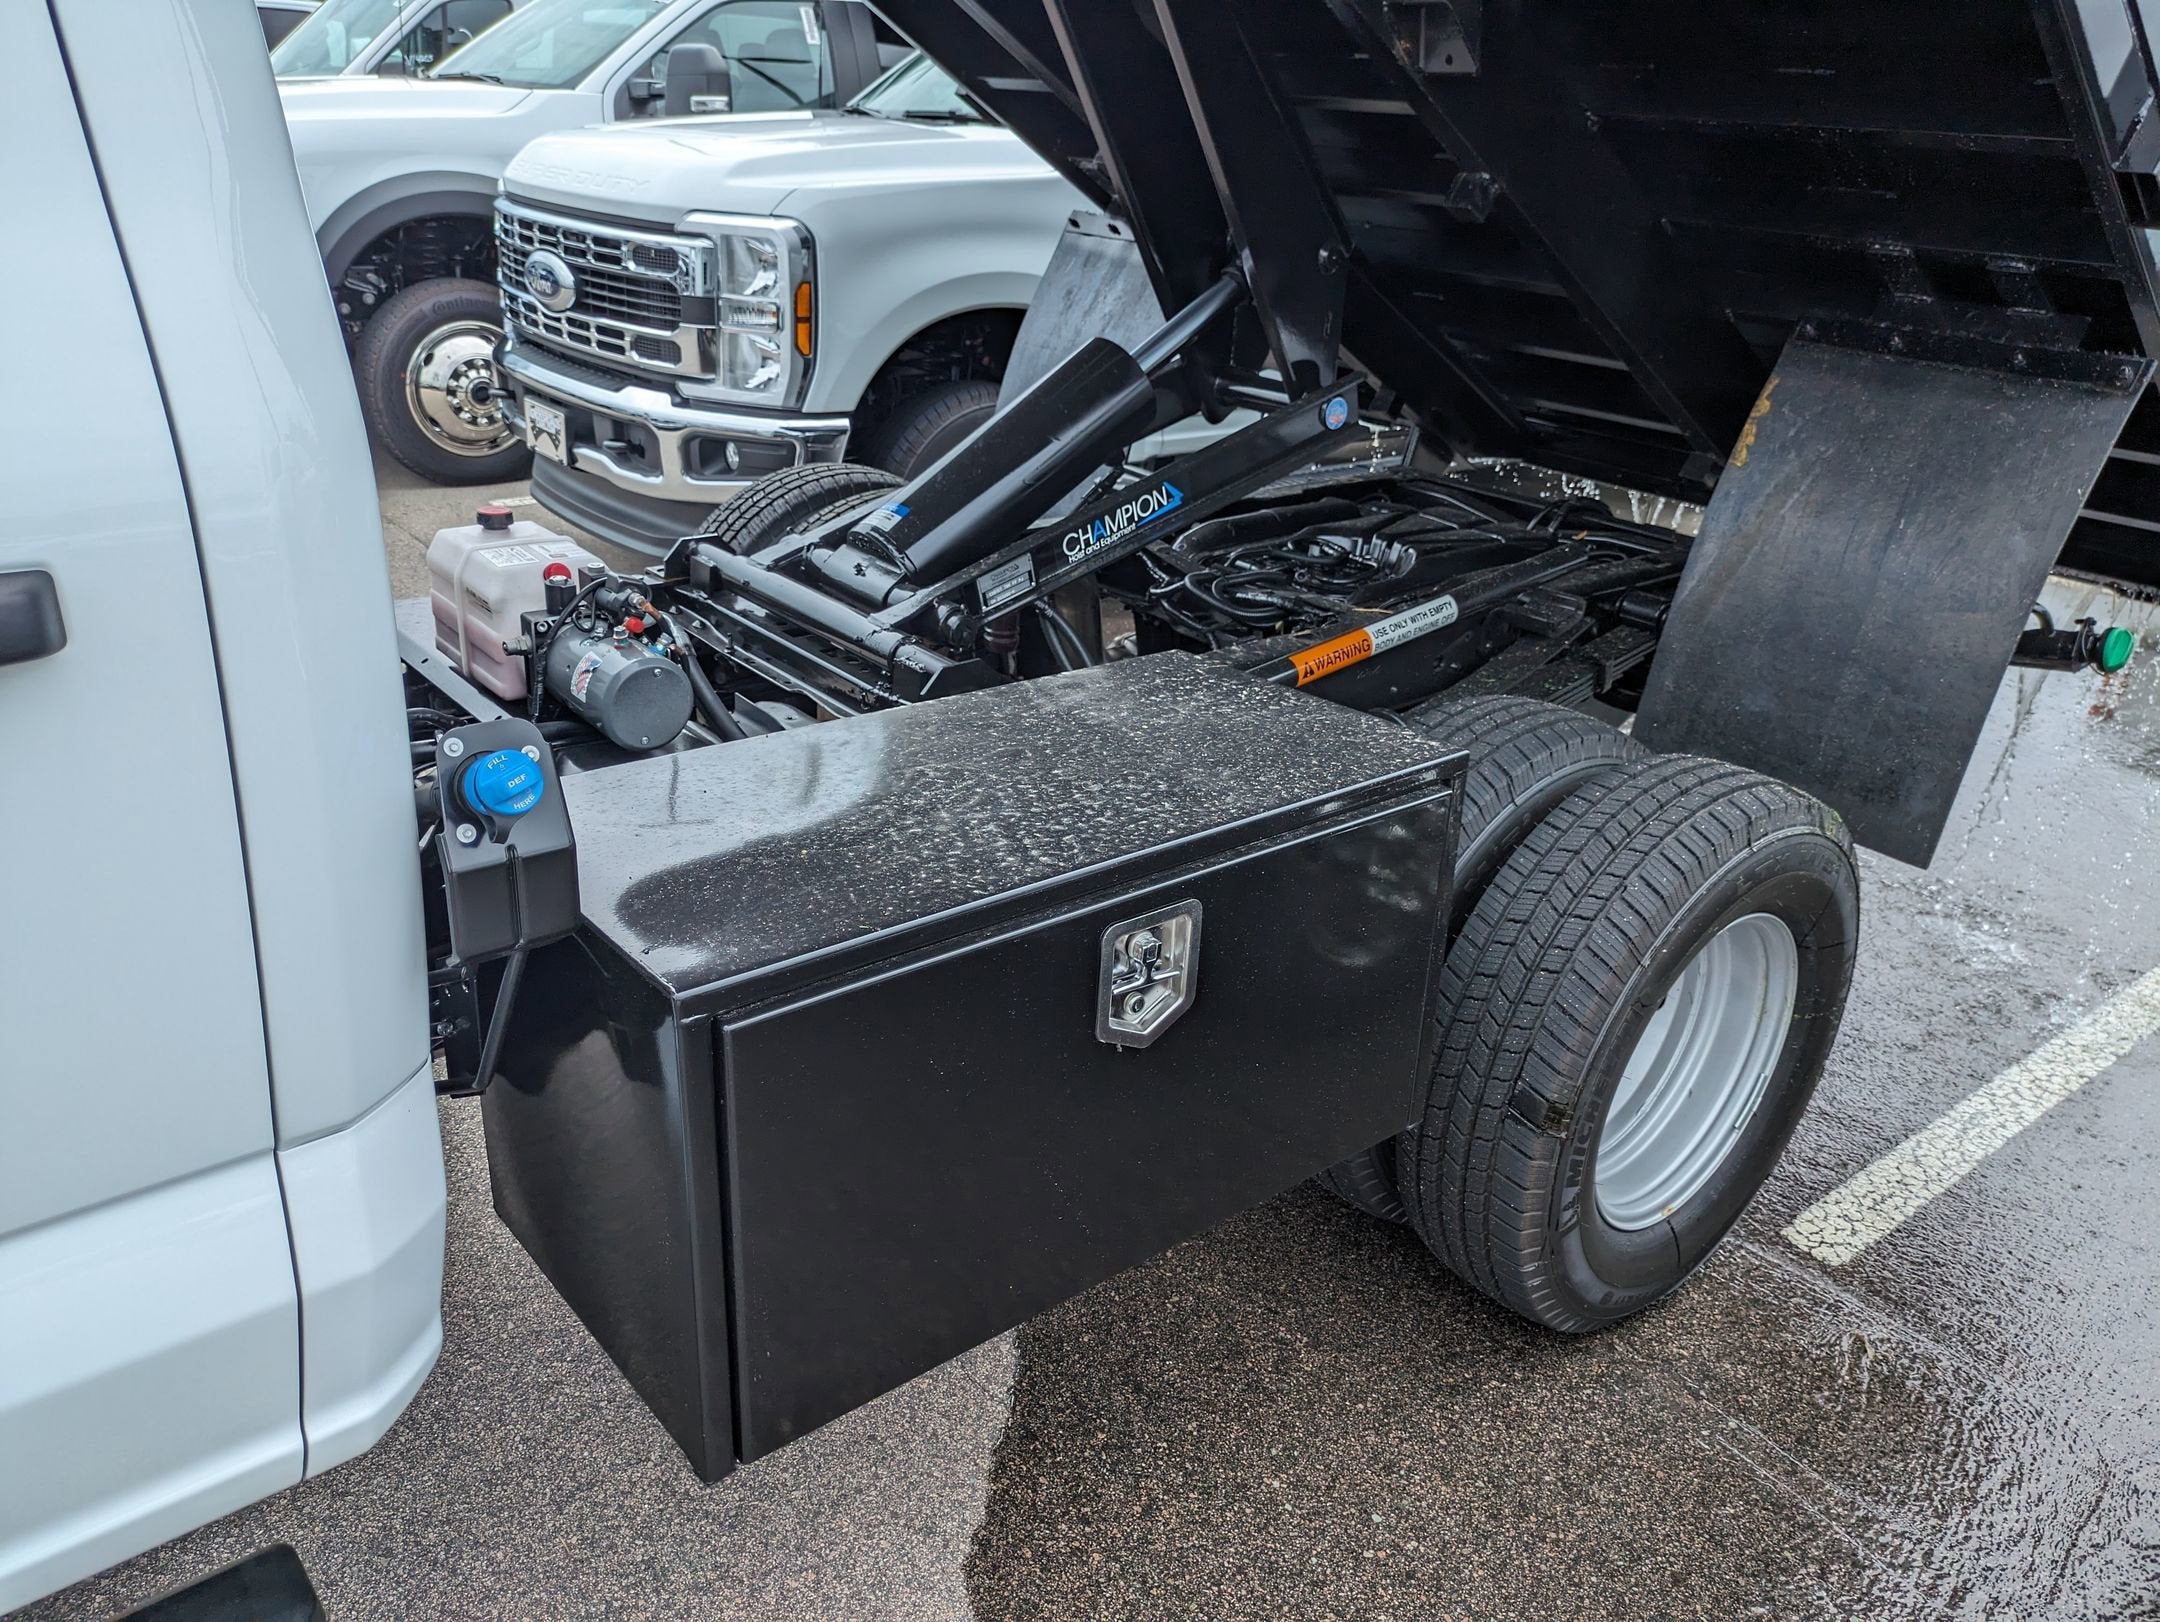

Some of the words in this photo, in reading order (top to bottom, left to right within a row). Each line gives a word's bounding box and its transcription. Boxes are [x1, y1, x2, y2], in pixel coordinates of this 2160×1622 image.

[574, 170, 651, 195] DUTY
[1062, 486, 1168, 556] CHAMPION
[1068, 549, 1086, 564] Hoist
[1085, 540, 1101, 555] and
[1100, 522, 1136, 547] Equipment
[1372, 627, 1389, 640] USE
[1388, 618, 1408, 633] ONLY
[1408, 611, 1429, 625] WITH
[1428, 601, 1453, 617] EMPTY
[1375, 637, 1395, 652] BODY
[1397, 630, 1412, 642] AND
[1413, 618, 1440, 636] ENGINE
[1441, 612, 1456, 625] OFF
[1314, 638, 1371, 671] WARNING
[487, 754, 508, 770] FILL
[507, 773, 527, 788] DEF
[513, 792, 536, 810] HERE
